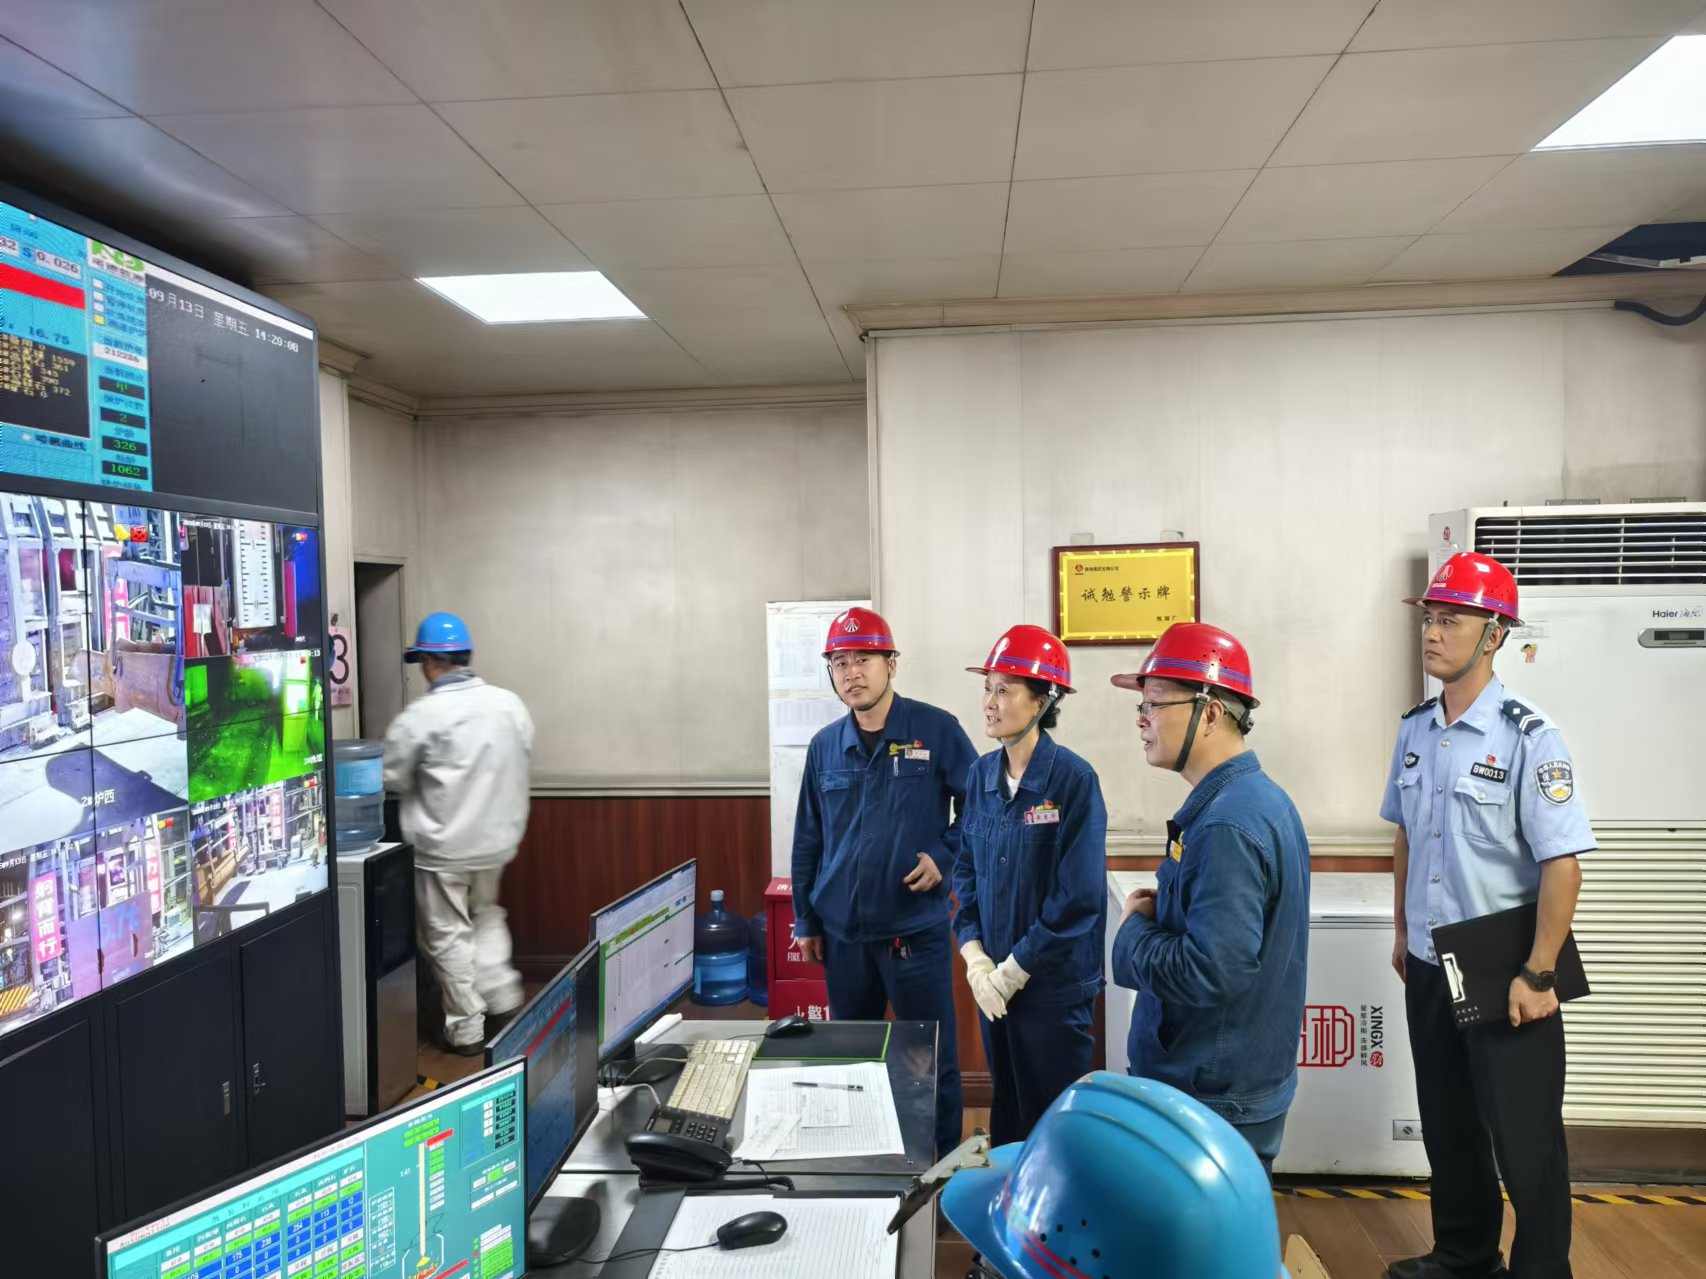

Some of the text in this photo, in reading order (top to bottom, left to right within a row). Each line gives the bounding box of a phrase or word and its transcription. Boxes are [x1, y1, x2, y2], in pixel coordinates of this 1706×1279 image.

[36, 251, 79, 274] 0.026
[213, 311, 250, 337] 星期五
[114, 439, 137, 452] 326
[111, 463, 141, 477] 1062
[1081, 585, 1171, 604] 诫勉警示牌
[1652, 610, 1679, 618] Haier
[1472, 763, 1505, 781] BW0013
